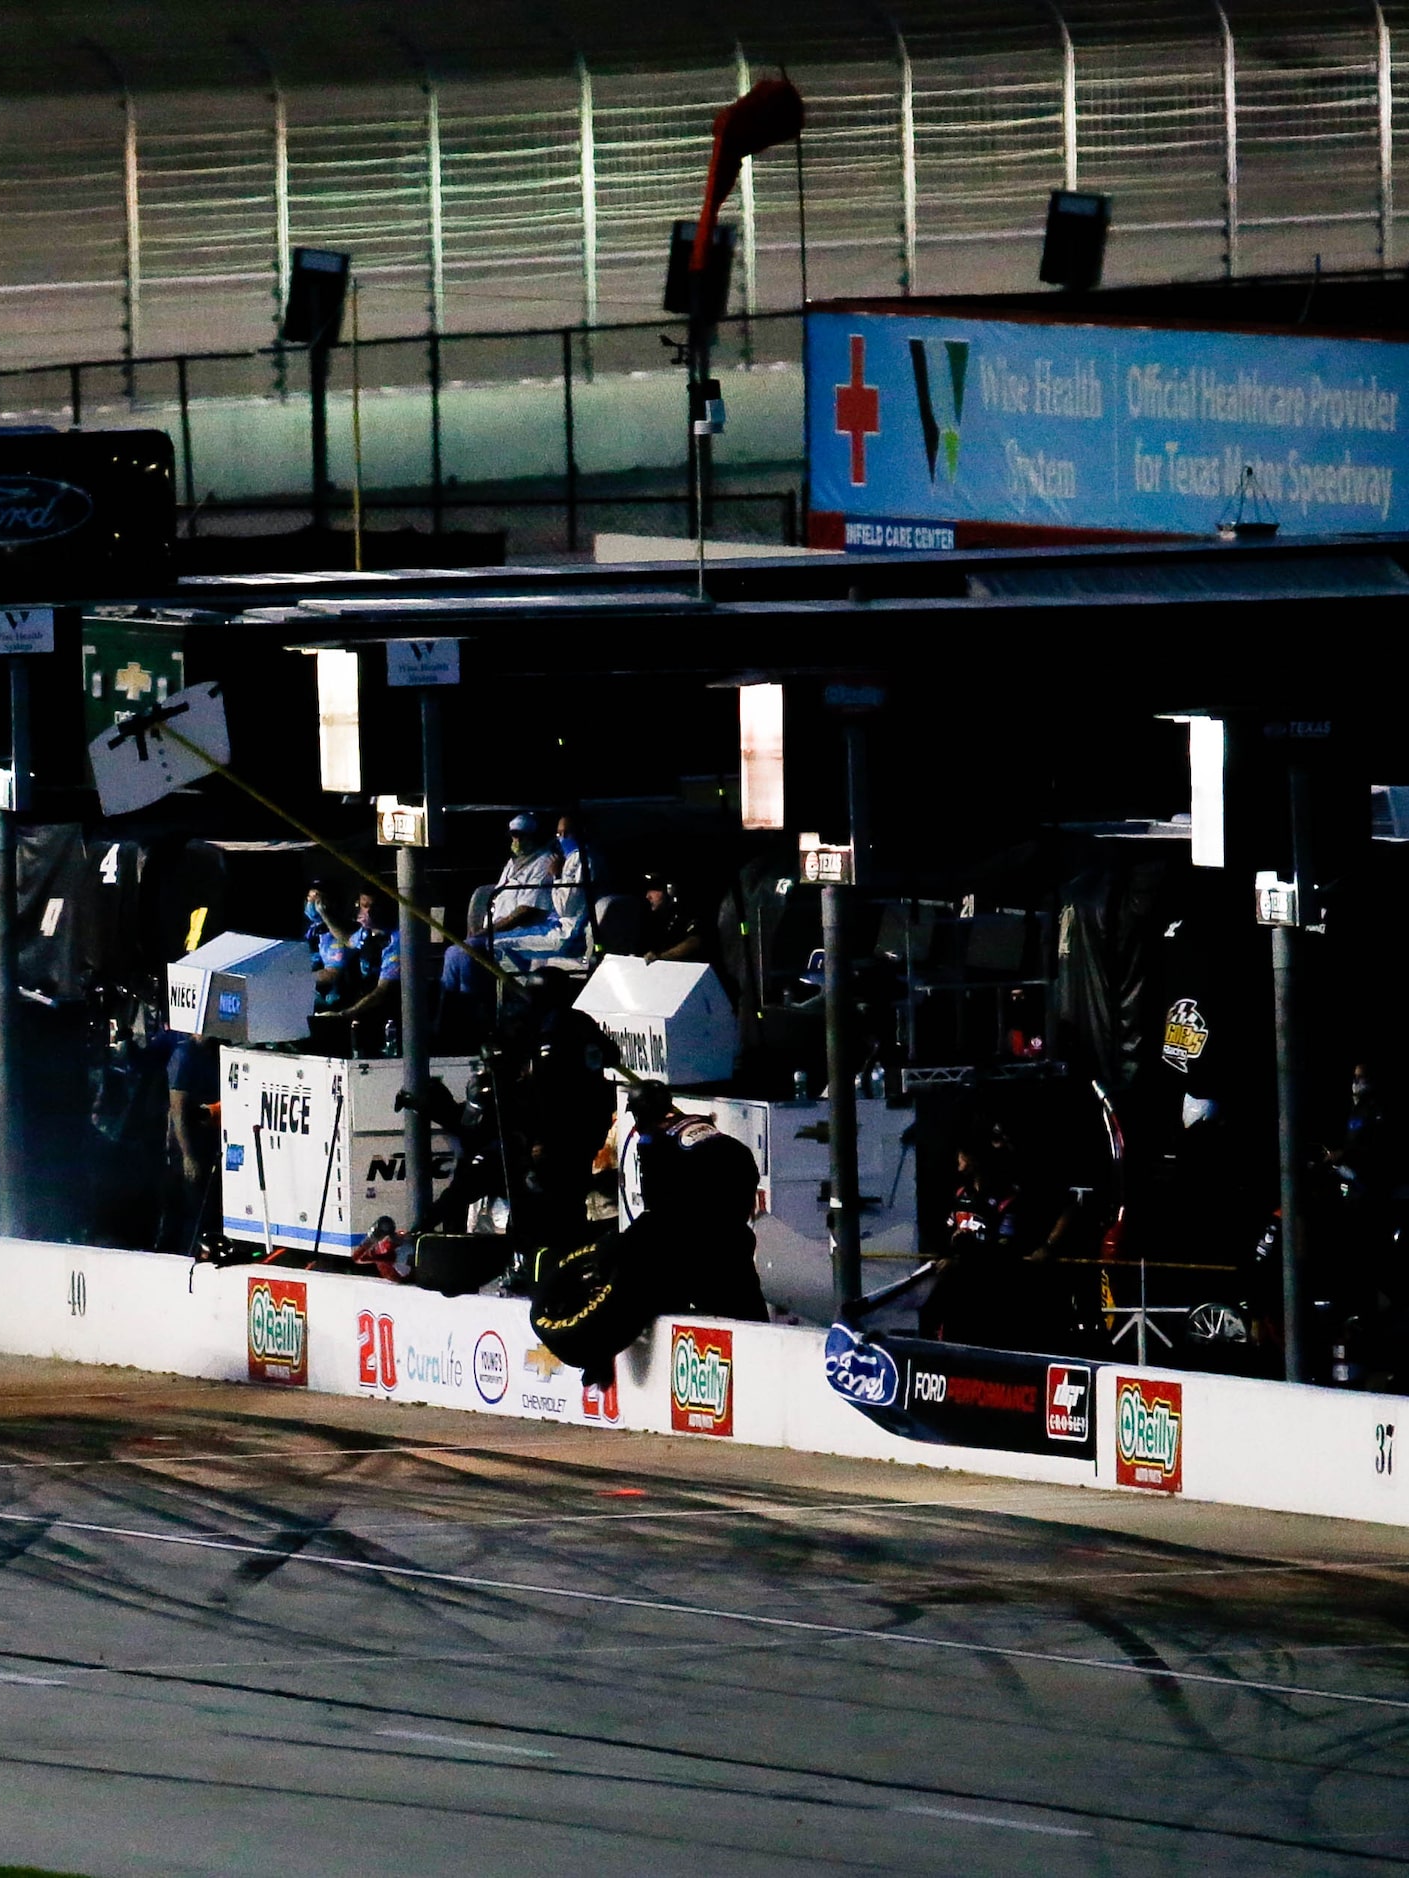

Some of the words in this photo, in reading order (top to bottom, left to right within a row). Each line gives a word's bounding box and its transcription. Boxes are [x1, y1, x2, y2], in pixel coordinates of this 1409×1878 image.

[978, 356, 1029, 415] Wise
[1035, 357, 1103, 418] Health
[1127, 362, 1196, 420] Official
[1201, 364, 1305, 428] Healthcare
[1310, 374, 1398, 433] Provider
[1135, 436, 1162, 493] for
[1164, 440, 1220, 497] Texas
[1287, 449, 1393, 521] Speedway
[845, 522, 884, 546] INFIELD
[885, 525, 913, 549] CARE
[914, 526, 954, 550] CENTER
[99, 843, 119, 884] 4
[170, 982, 196, 1010] NIECE
[260, 1082, 312, 1135] NIECE
[67, 1270, 86, 1317] 40
[252, 1291, 303, 1366] O'Reilly
[356, 1309, 399, 1392] 20
[407, 1331, 463, 1388] CuraLife
[672, 1338, 729, 1416] O'Reilly
[825, 1349, 886, 1401] Ford
[521, 1393, 567, 1413] CHEVROLET
[914, 1371, 947, 1402] FORD
[946, 1376, 1038, 1413] PERFORMANCE
[1049, 1413, 1088, 1433] CROSLEY
[1120, 1391, 1179, 1471] O'Reilly
[1375, 1423, 1395, 1476] 37
